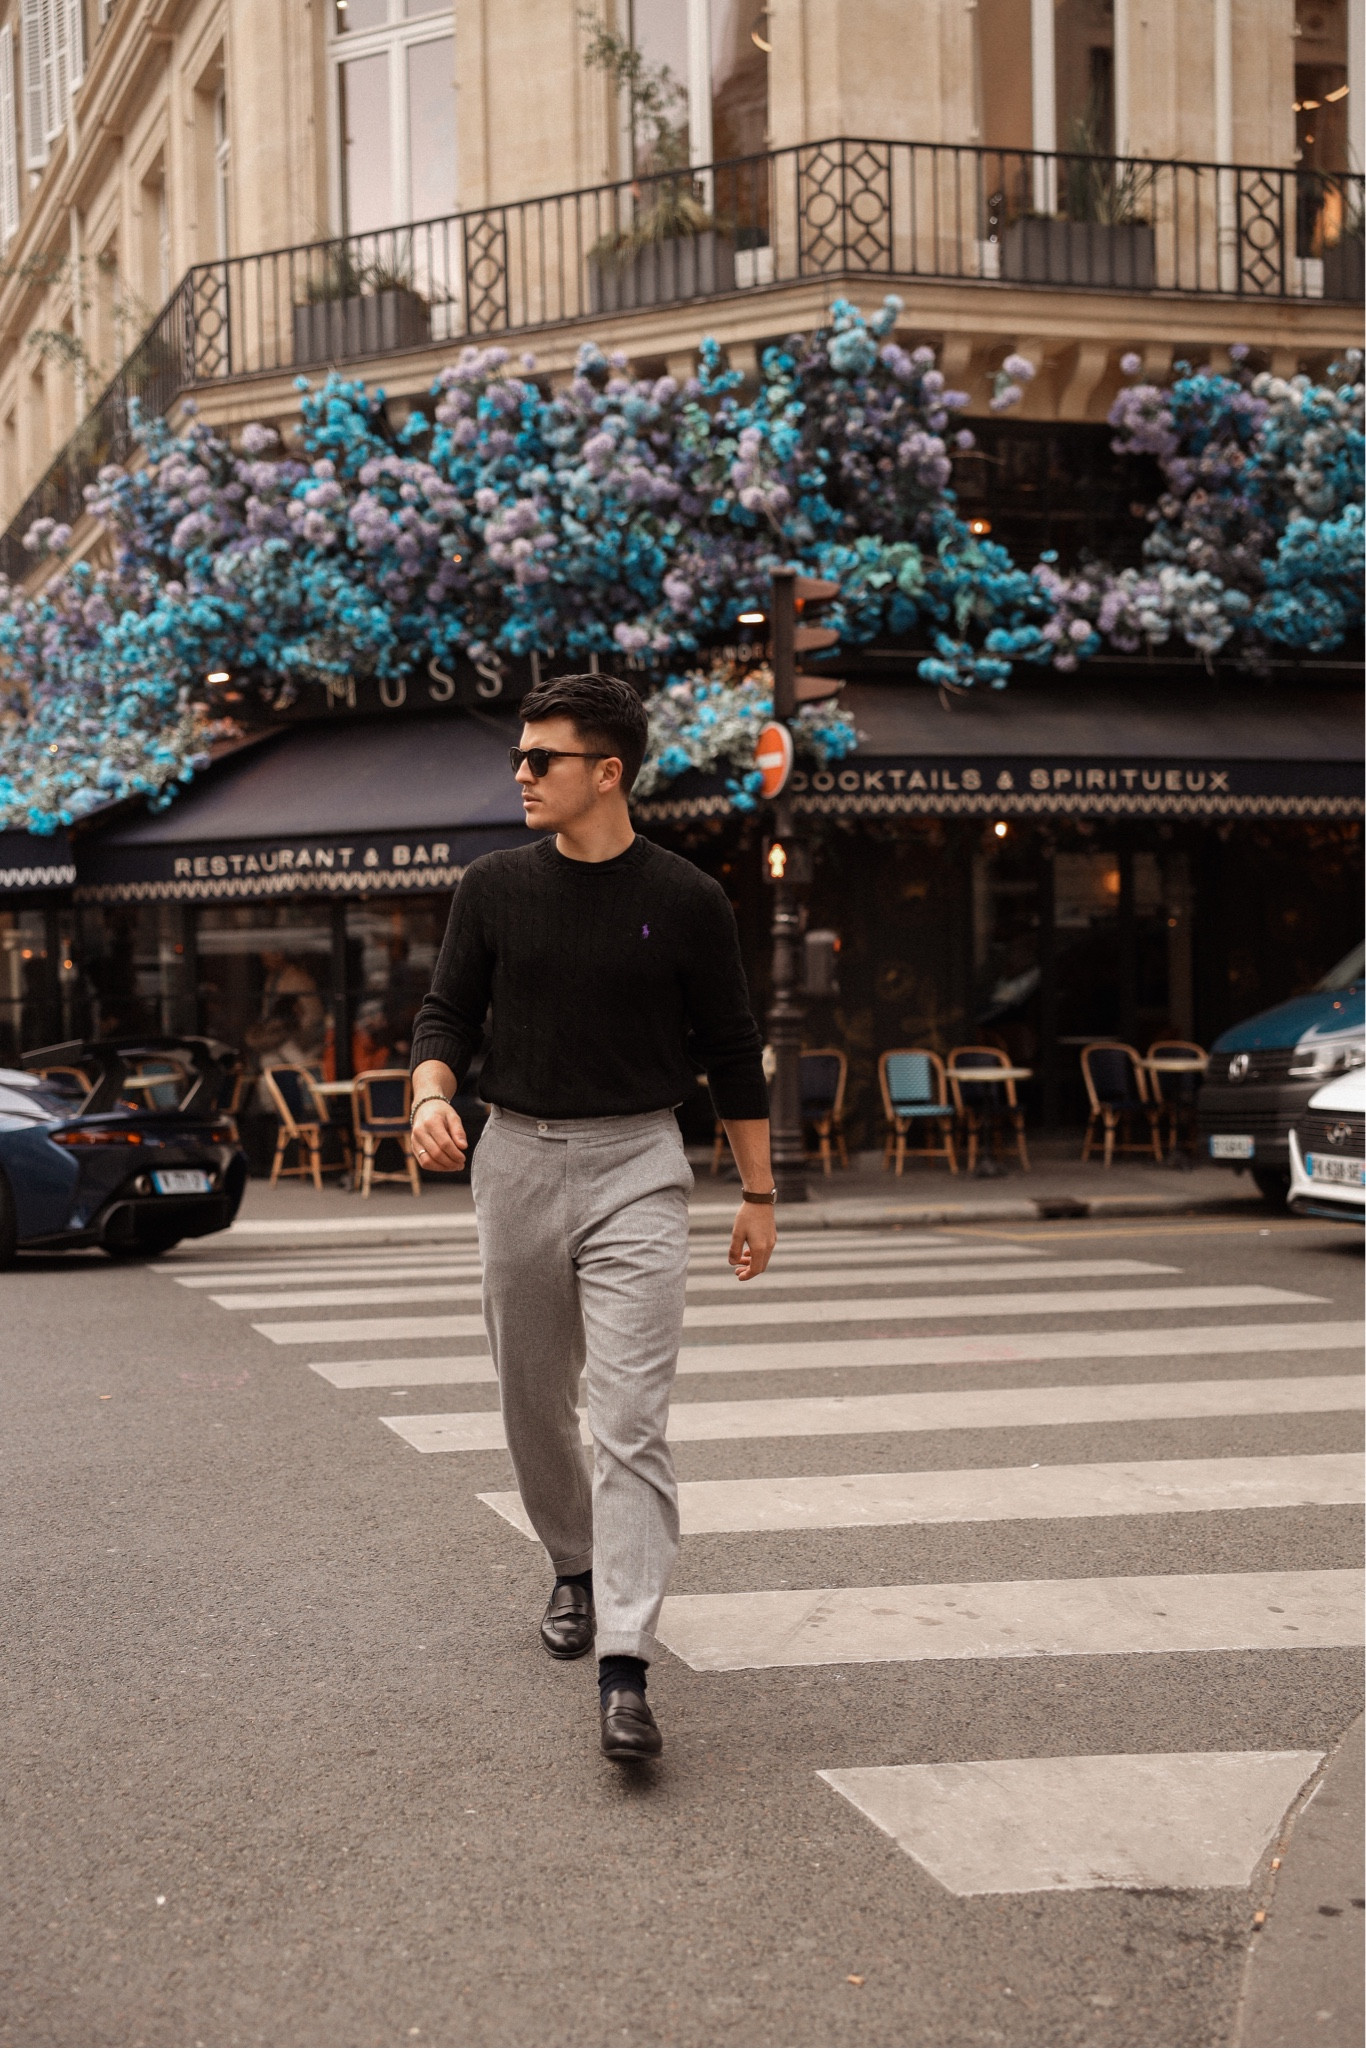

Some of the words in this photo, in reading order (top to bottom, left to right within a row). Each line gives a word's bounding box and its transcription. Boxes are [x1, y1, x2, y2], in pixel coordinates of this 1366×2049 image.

[791, 769, 982, 791] COCKTAILS
[998, 769, 1013, 790] &
[1029, 768, 1229, 792] SPIRITUEUX
[174, 848, 355, 877] RESTAURANT
[364, 847, 379, 867] &
[392, 843, 449, 866] BAR
